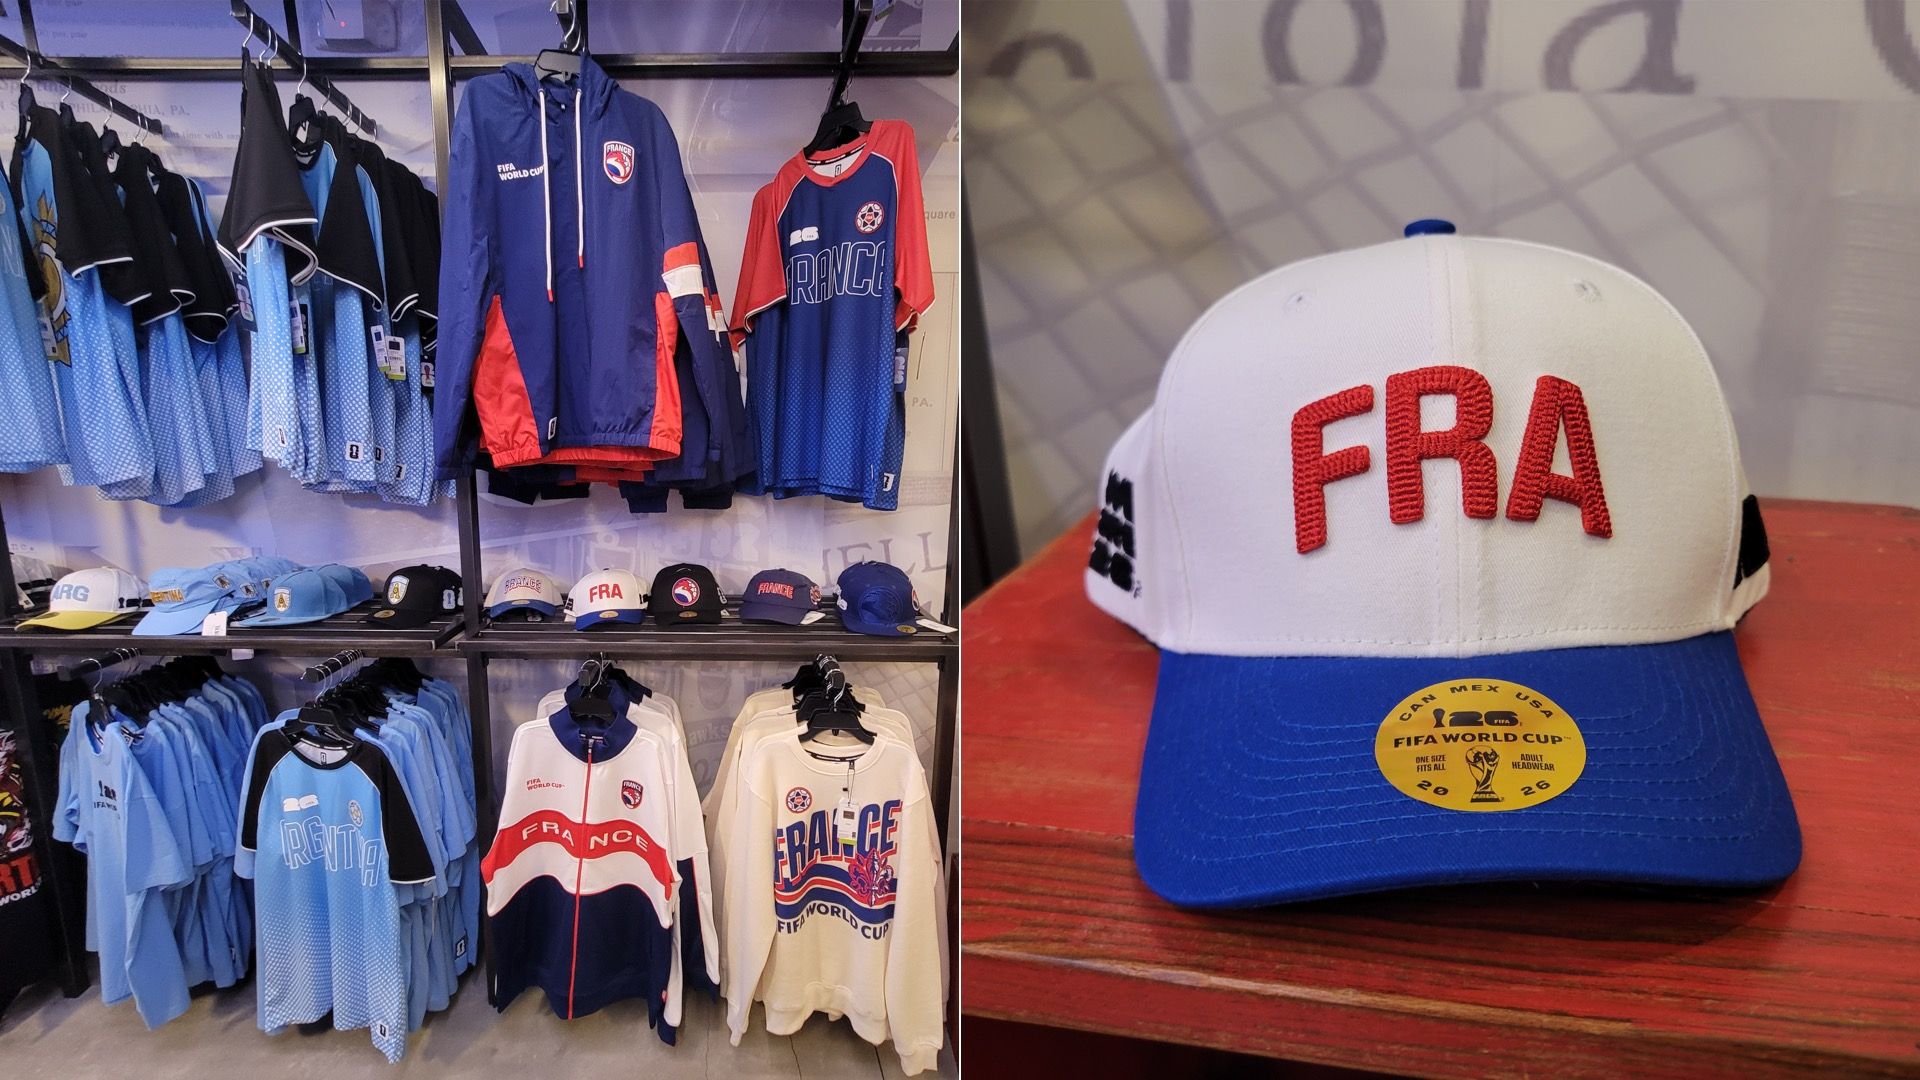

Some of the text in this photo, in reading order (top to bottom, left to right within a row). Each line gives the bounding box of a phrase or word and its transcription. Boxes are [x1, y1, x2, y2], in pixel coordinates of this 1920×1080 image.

[606, 143, 632, 156] FRANCE
[497, 162, 516, 173] FIFA
[499, 169, 529, 181] WORLD
[1291, 364, 1612, 554] FRA
[589, 583, 623, 603] FRA
[757, 581, 794, 600] FRANCE
[1399, 683, 1554, 722] CAN MEX USA
[1393, 734, 1438, 748] FIFA
[1441, 732, 1518, 743] WORLD
[1415, 754, 1447, 764] ONE SIZE
[1520, 753, 1543, 762] ADULT
[1416, 762, 1446, 772] FITS ALL
[1511, 761, 1555, 772] HEADWEAR
[527, 782, 551, 791] WORLD
[777, 902, 889, 940] FIFA WORLD CUP
